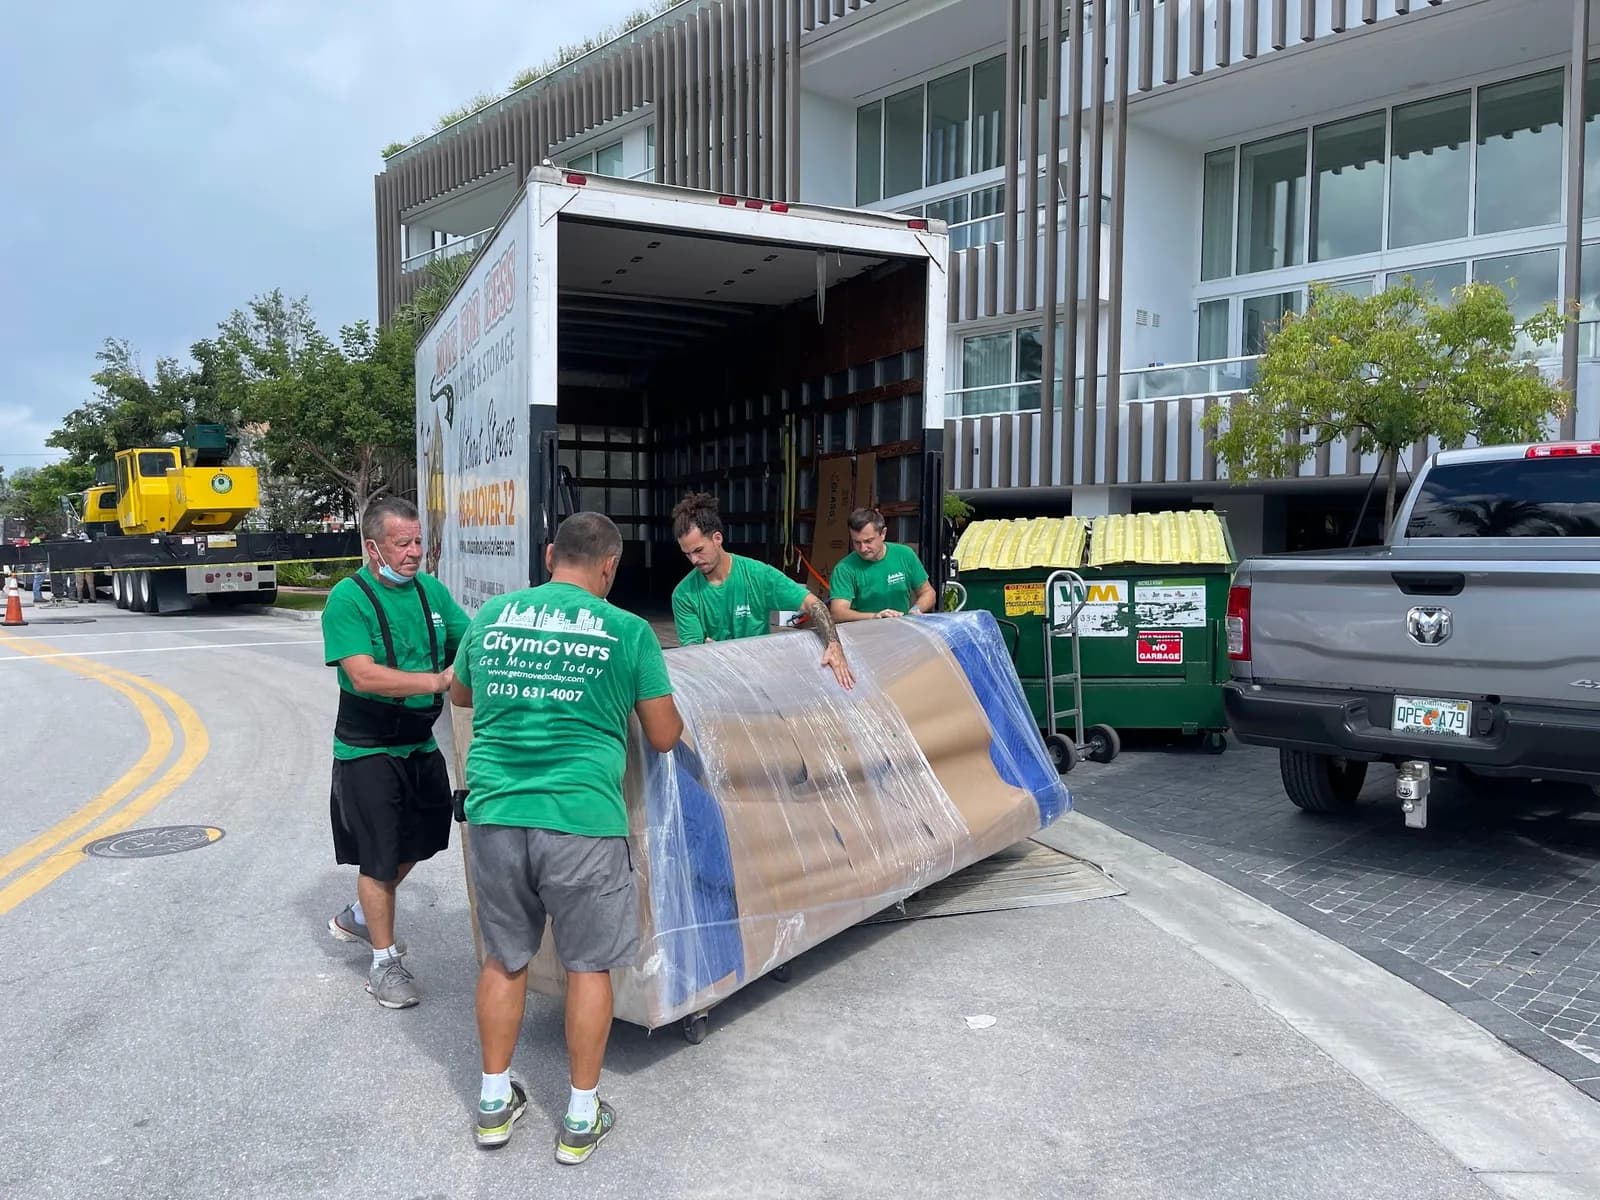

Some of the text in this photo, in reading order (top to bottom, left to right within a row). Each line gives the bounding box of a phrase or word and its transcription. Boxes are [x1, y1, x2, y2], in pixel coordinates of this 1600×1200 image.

[460, 289, 480, 359] FOR
[484, 241, 515, 335] LESS
[483, 328, 515, 382] STORAGE
[485, 398, 515, 464] Stress
[1059, 585, 1119, 602] WM
[483, 631, 611, 661] Citymovers
[480, 655, 604, 678] Get Moved Today
[488, 669, 585, 683] www.getmovedtoday.com
[487, 682, 584, 702] (213) 631-4007
[1439, 710, 1465, 729] A79
